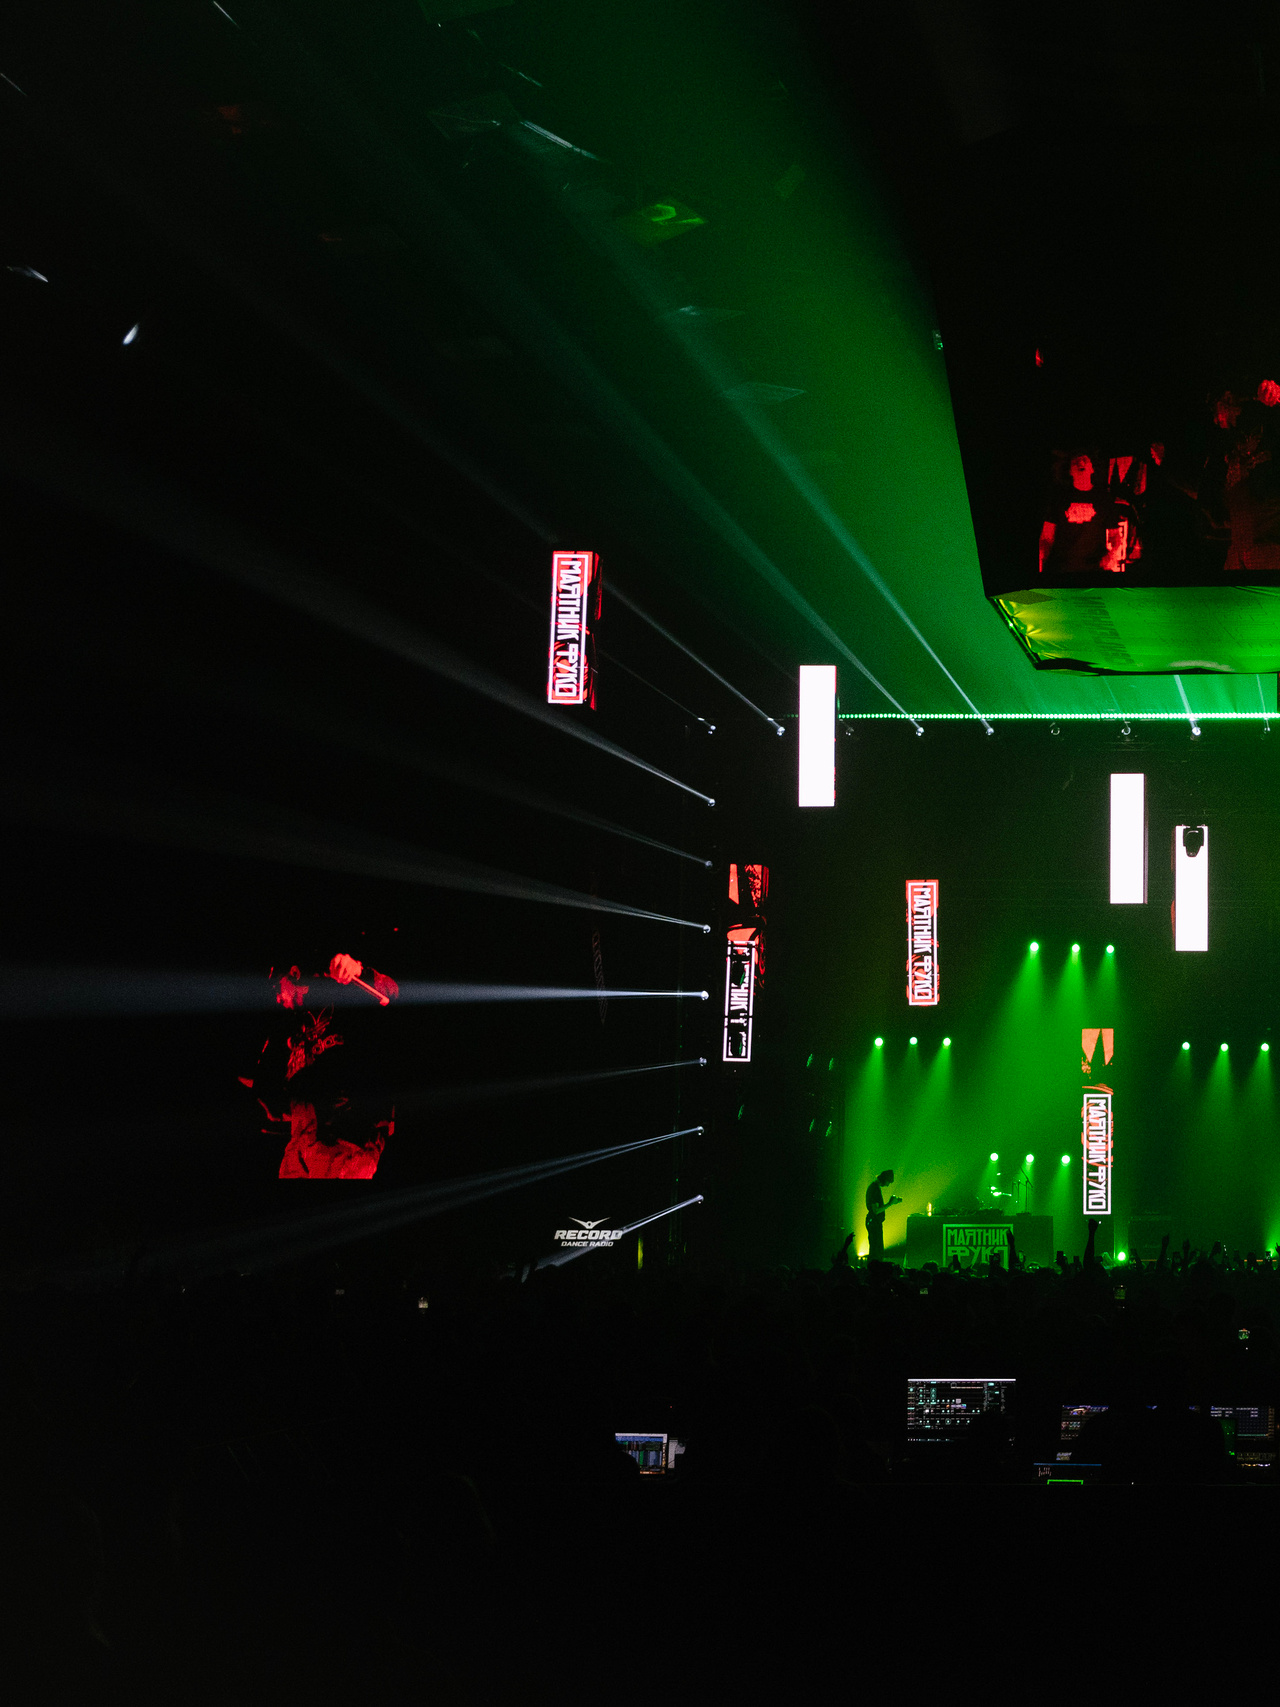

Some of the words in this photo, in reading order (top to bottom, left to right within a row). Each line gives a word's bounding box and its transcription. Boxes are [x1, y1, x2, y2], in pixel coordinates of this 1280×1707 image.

[557, 561, 582, 640] МАЯТНИК
[555, 644, 578, 696] ФУКО
[914, 888, 931, 953] МАЯТНИК
[914, 955, 932, 999] ФУКО
[1088, 1100, 1106, 1164] МАЯТНИК
[1088, 1166, 1106, 1209] ФУКО
[554, 1230, 623, 1240] RECORD
[948, 1229, 1009, 1245] МАЯТНИК
